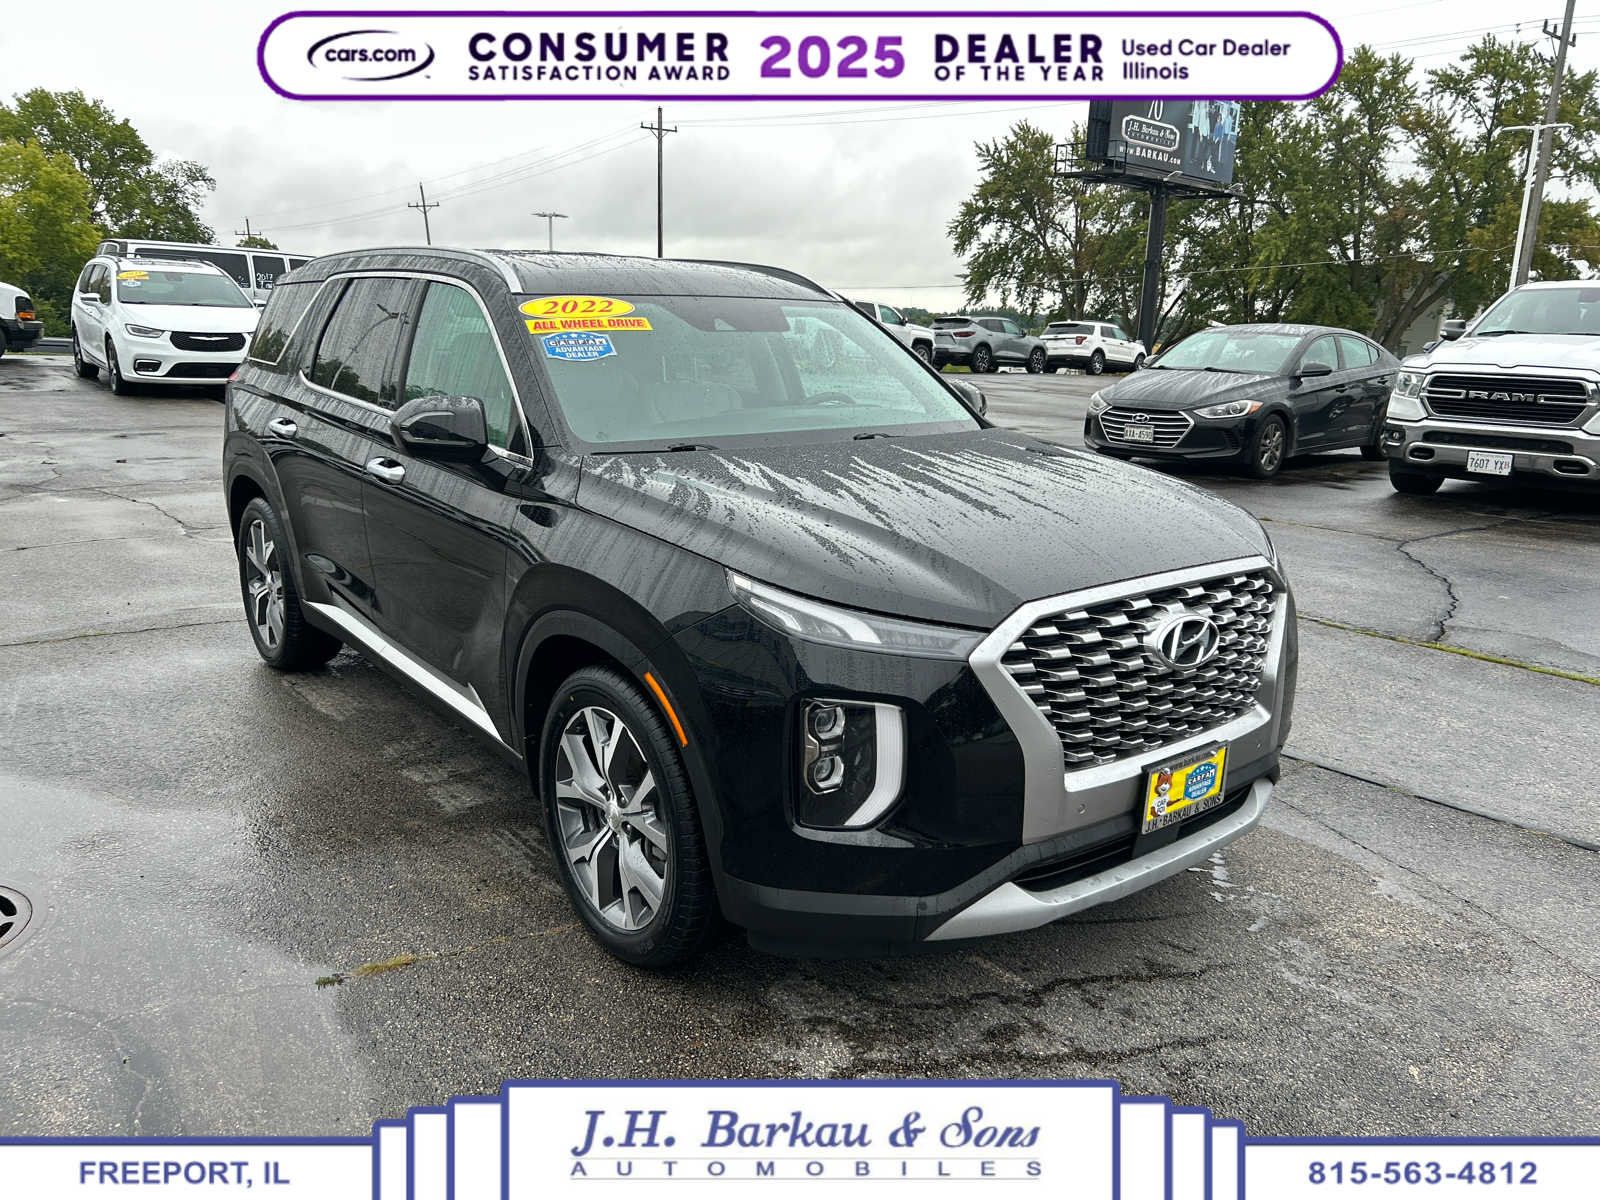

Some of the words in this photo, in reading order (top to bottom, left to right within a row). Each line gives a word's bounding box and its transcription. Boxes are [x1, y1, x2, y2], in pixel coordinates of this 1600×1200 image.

[542, 300, 614, 315] 2022
[533, 319, 557, 331] ALL
[561, 318, 607, 330] WHEEL
[608, 317, 643, 328] DRIVE
[1469, 390, 1534, 402] RAM
[1470, 457, 1489, 470] 7607
